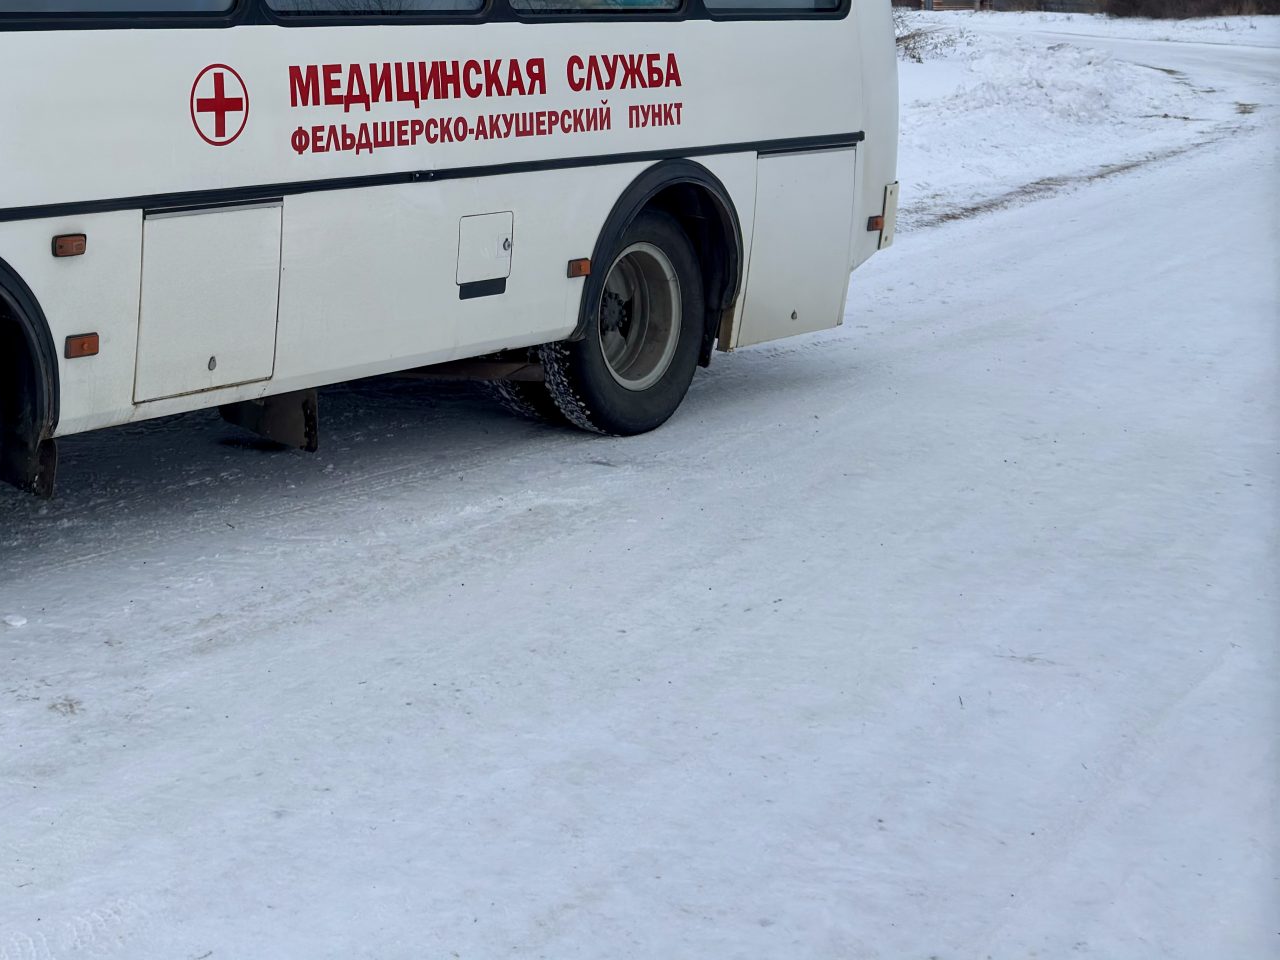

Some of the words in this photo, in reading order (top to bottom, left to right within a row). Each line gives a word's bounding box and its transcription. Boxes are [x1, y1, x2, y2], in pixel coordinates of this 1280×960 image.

[288, 57, 547, 112] МЕДИЦИНСКАЯ
[566, 52, 683, 92] СЛУЖБА
[290, 100, 612, 155] ФЕЛЬДШЕРСКО-АКУШЕРСКИЙ
[628, 102, 684, 129] ПУНКТ
